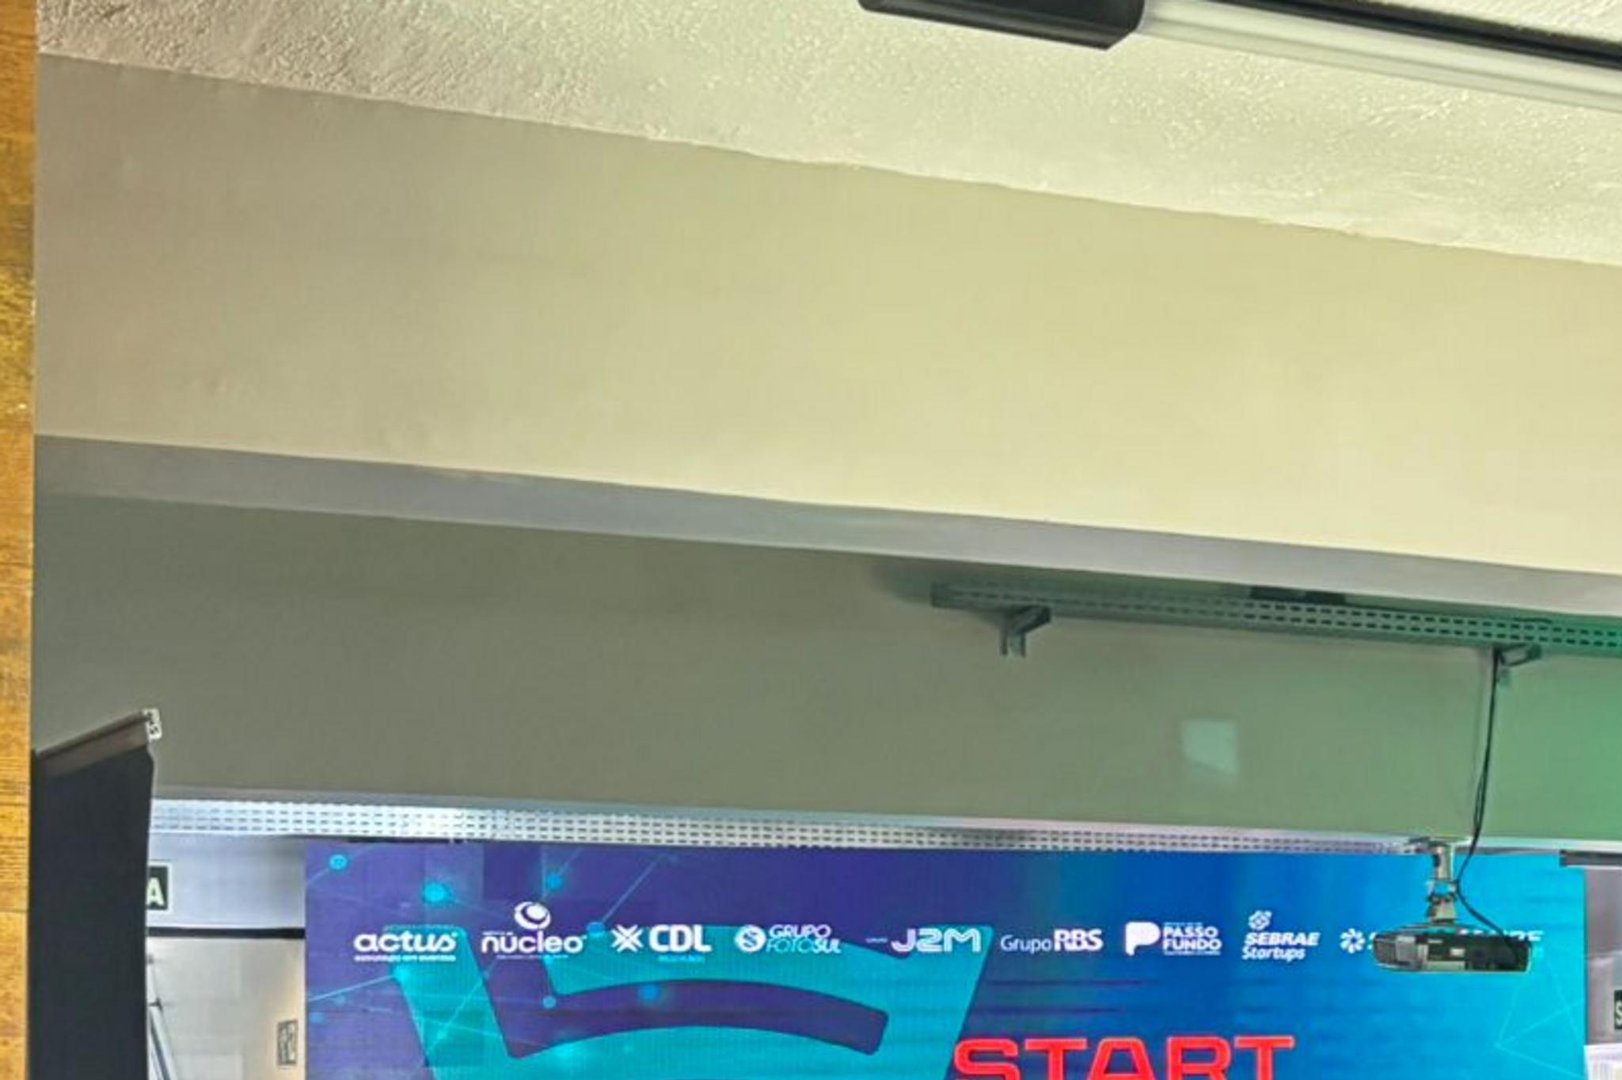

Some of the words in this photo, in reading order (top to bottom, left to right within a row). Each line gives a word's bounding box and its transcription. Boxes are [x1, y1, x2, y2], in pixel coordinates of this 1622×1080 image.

[648, 923, 712, 953] CDL
[768, 924, 832, 939] GRUPO
[1163, 926, 1218, 938] PASSO
[1245, 931, 1321, 946] SEBRAE
[353, 930, 457, 953] actus
[890, 927, 982, 953] J2M
[1053, 928, 1104, 952] RBS
[1163, 938, 1222, 950] FUNDO
[1241, 947, 1306, 962] Startups
